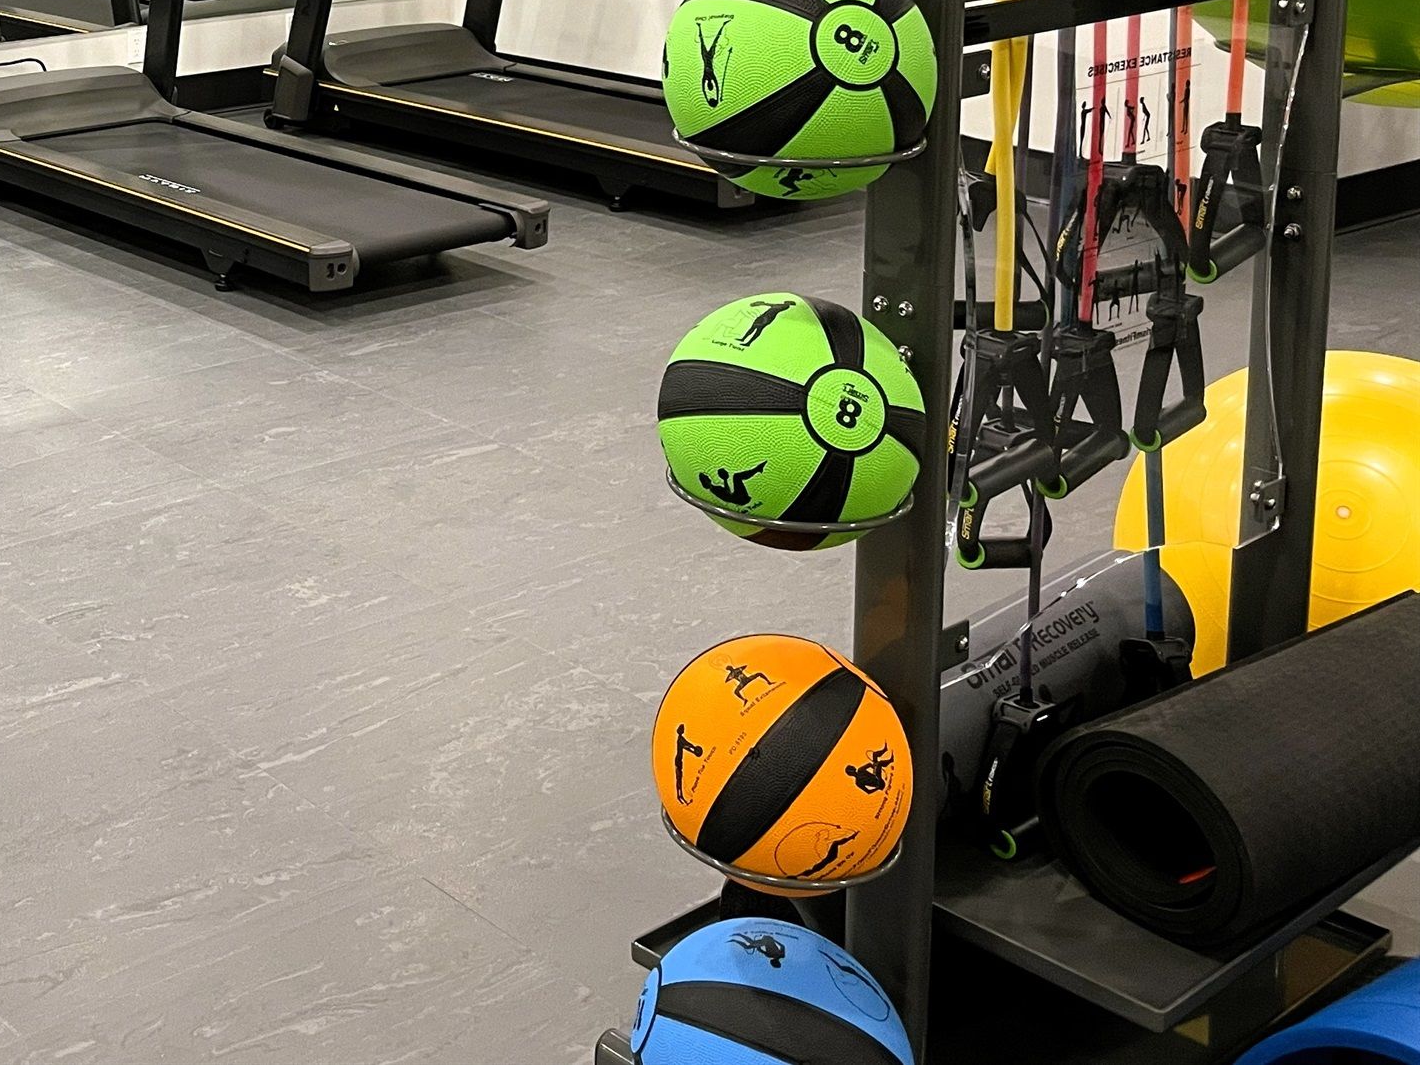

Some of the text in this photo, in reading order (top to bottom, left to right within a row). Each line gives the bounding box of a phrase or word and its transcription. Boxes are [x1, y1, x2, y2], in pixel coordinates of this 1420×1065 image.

[833, 23, 867, 54] 8
[835, 396, 863, 429] 8
[1039, 644, 1070, 670] MUSCLE
